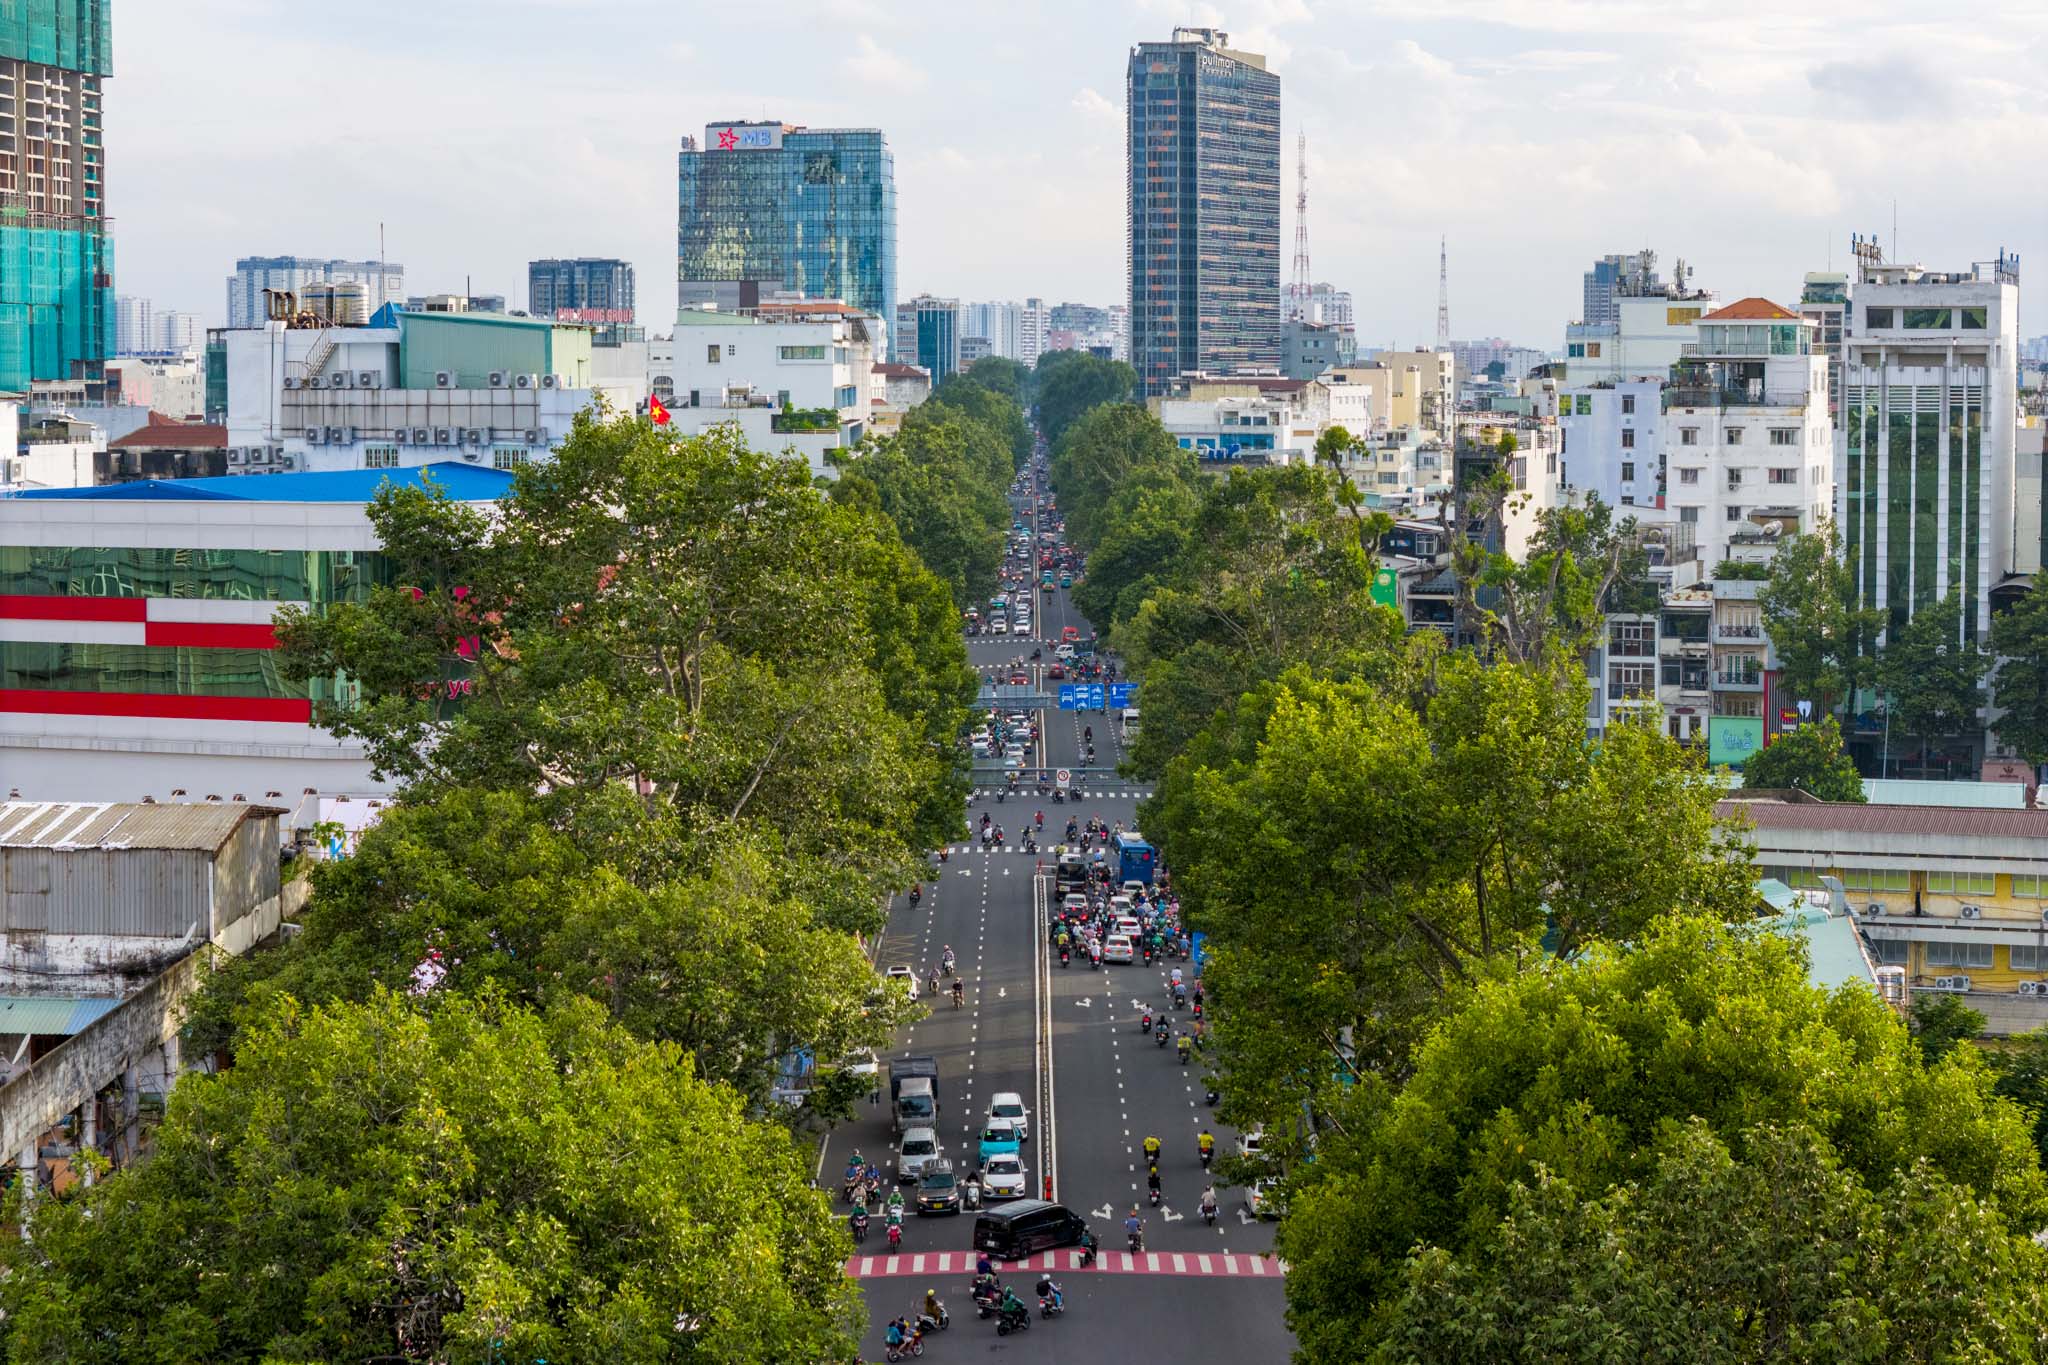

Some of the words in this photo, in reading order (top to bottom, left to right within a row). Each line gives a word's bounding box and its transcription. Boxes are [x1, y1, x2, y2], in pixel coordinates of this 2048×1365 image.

[1202, 54, 1235, 72] pullman
[741, 128, 771, 146] MB
[606, 309, 633, 322] GROUP
